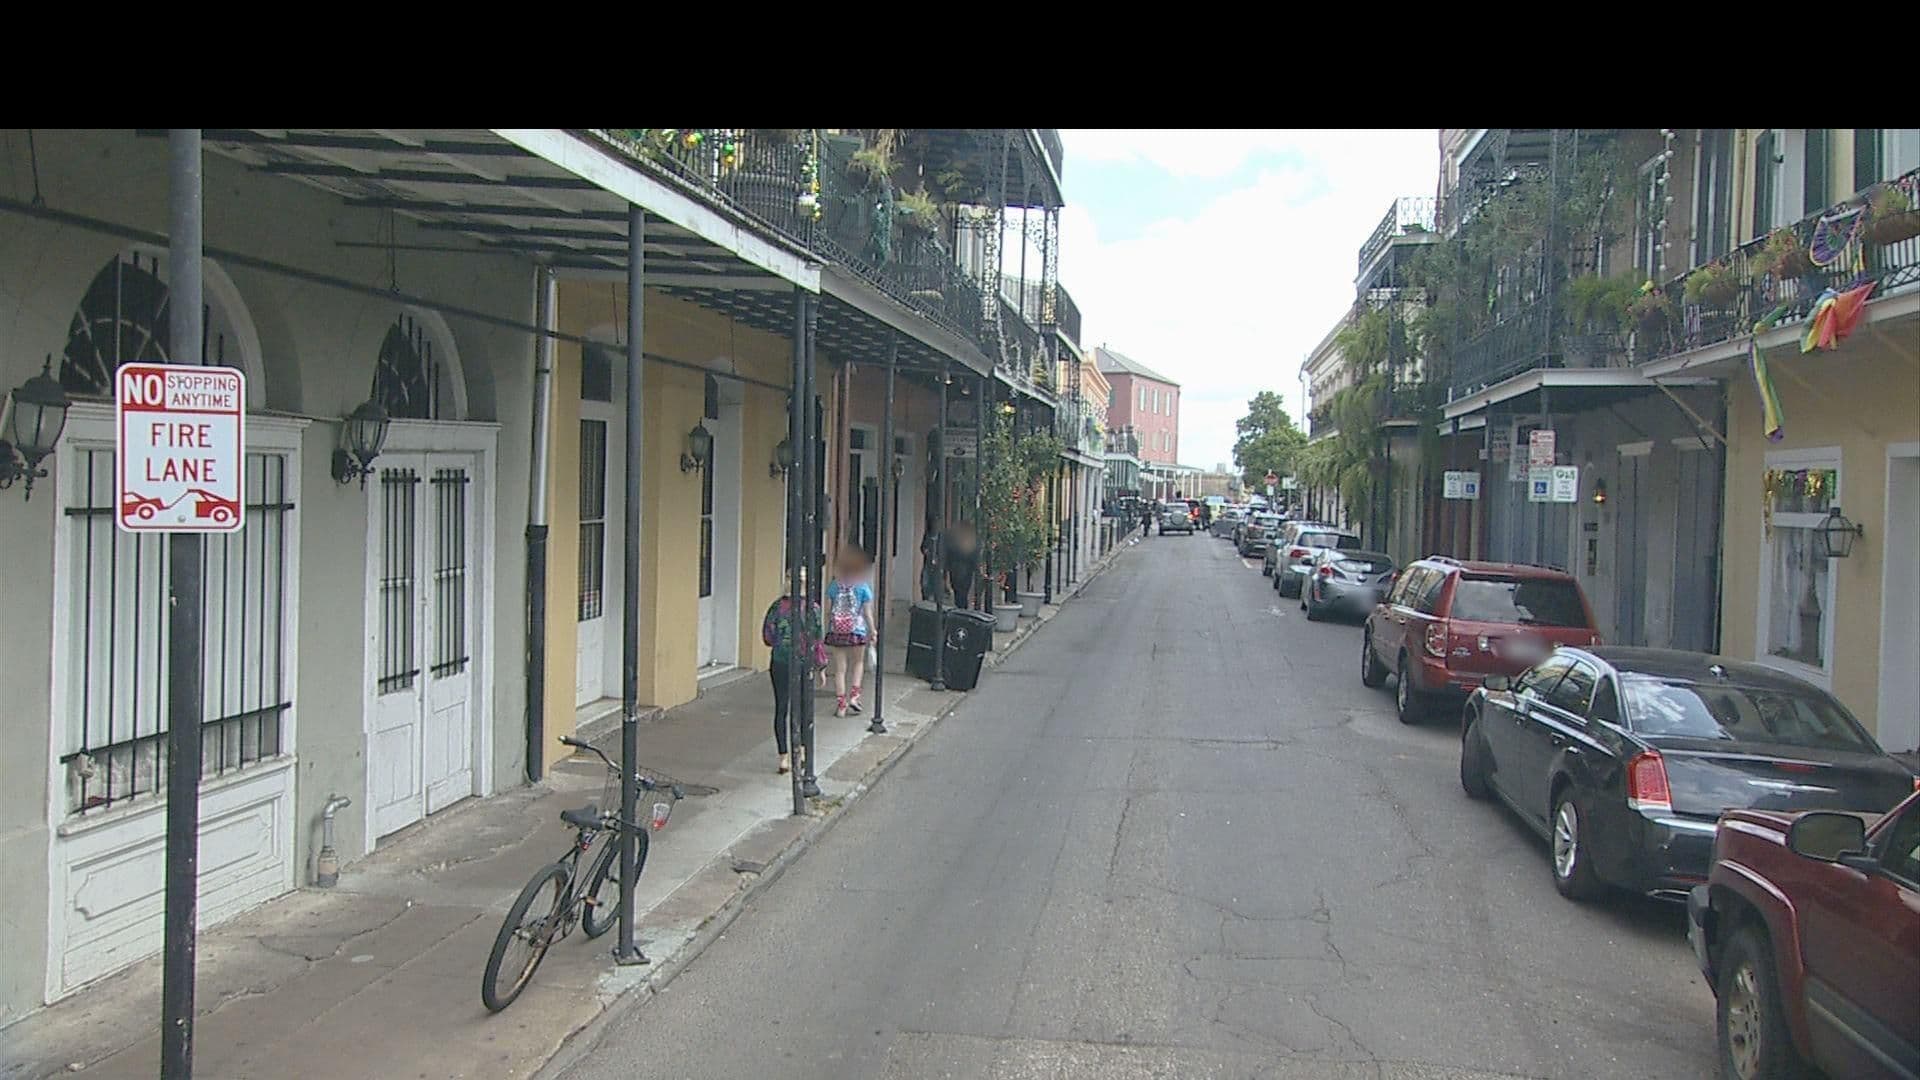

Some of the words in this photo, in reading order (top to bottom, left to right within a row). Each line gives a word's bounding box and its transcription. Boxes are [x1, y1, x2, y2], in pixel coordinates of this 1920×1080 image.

[124, 373, 164, 406] NO
[167, 375, 237, 392] STOPPING
[171, 392, 232, 408] ANYTIME
[151, 422, 213, 448] FIRE
[146, 457, 218, 483] LANE
